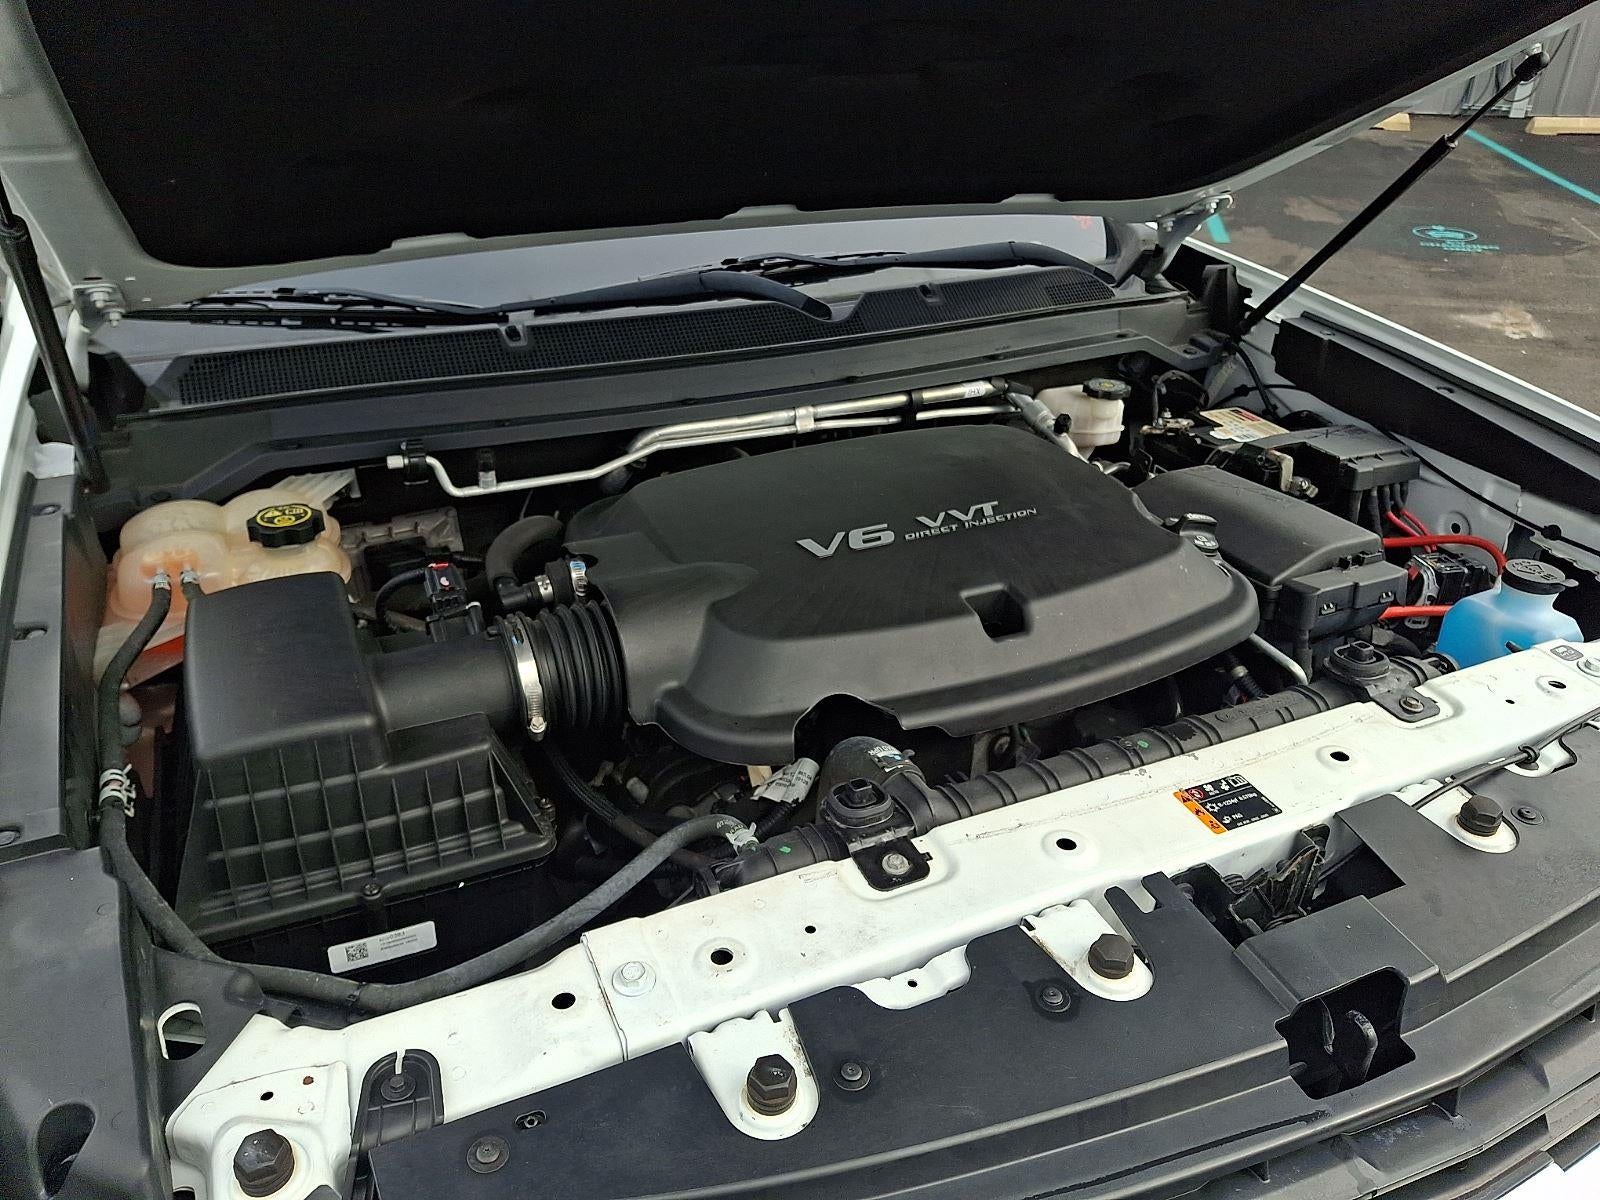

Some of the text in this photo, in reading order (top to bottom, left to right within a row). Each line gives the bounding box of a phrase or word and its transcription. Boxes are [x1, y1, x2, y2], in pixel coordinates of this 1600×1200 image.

[796, 500, 999, 559] V6 VVT
[904, 507, 1037, 542] DIRECT INJECTION
